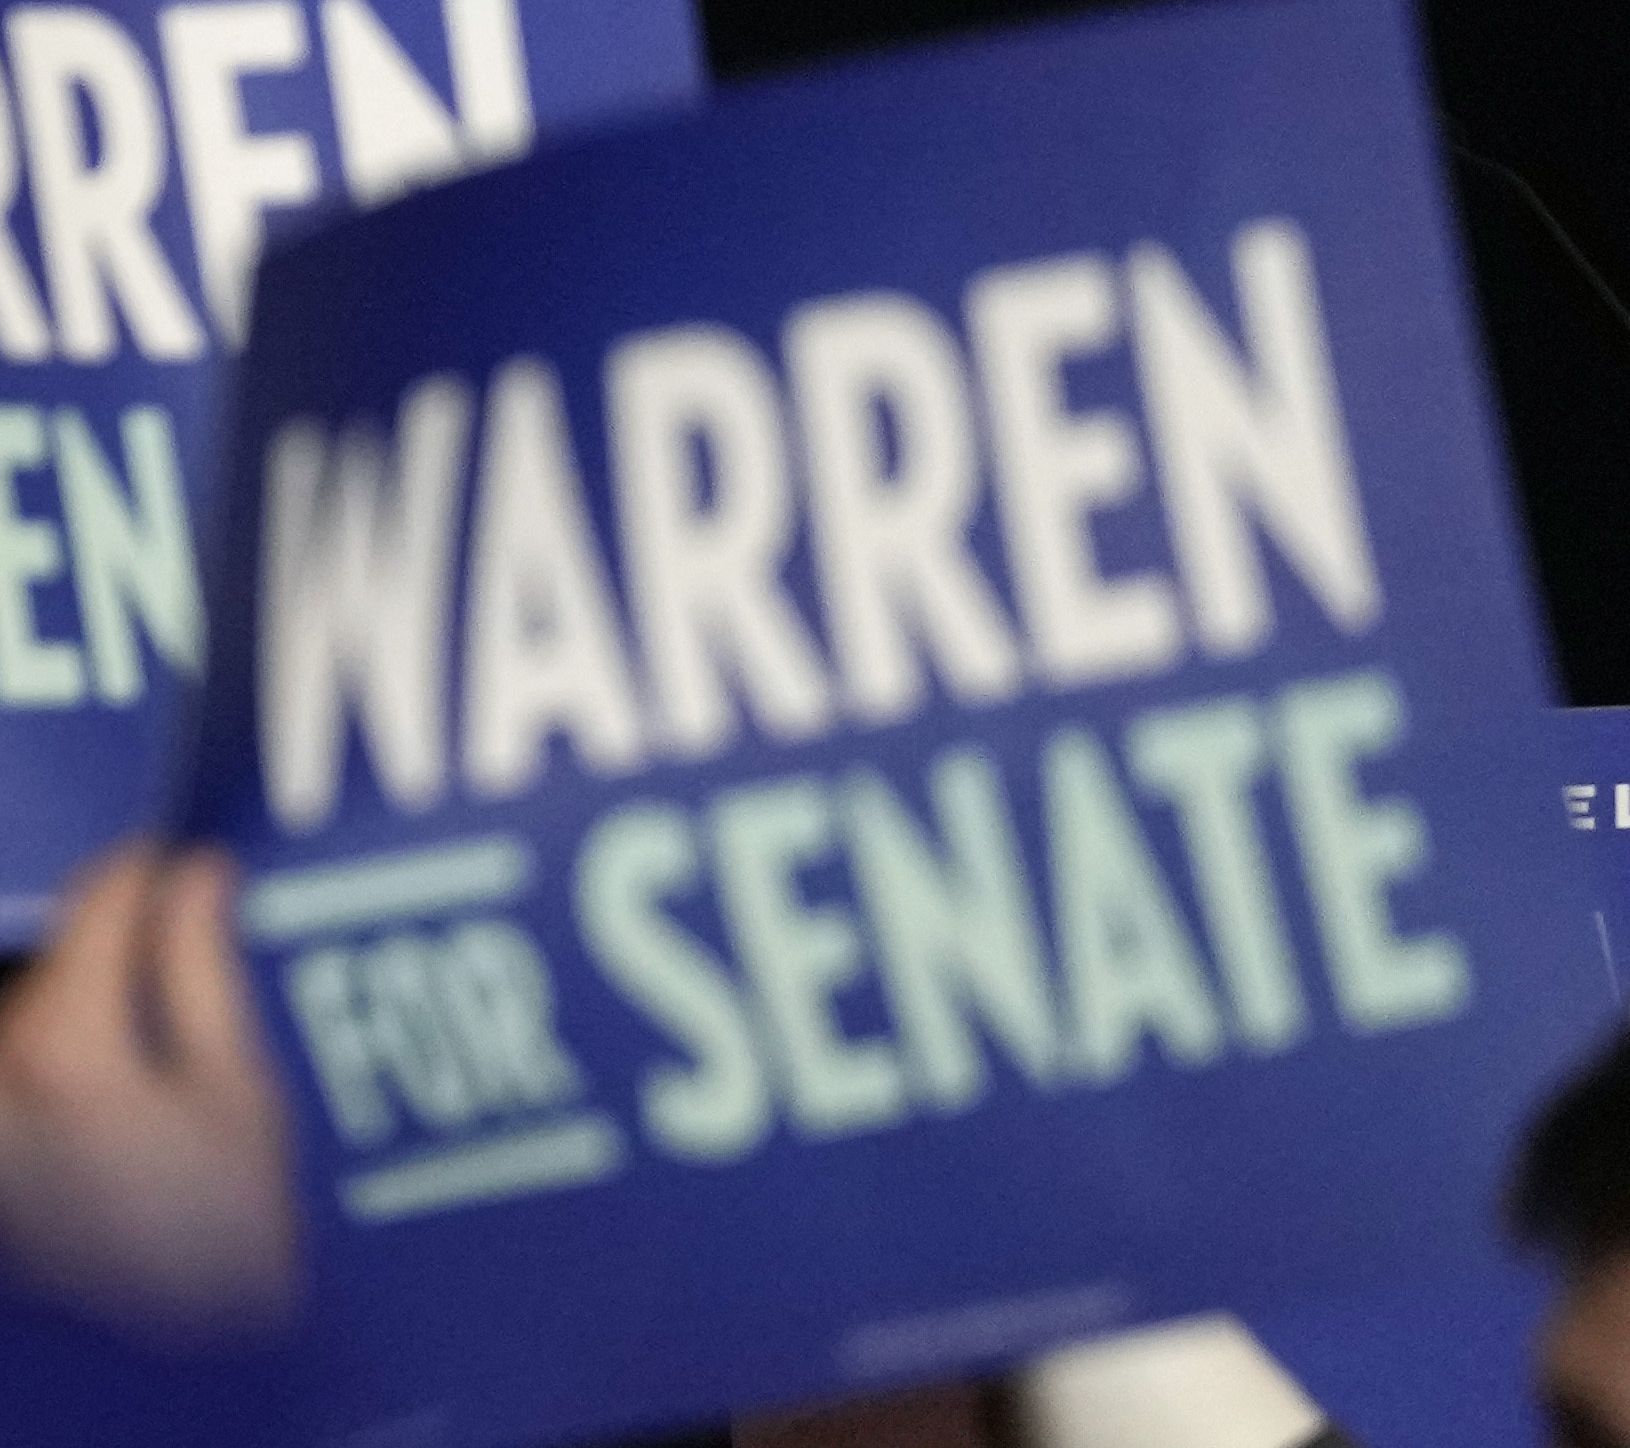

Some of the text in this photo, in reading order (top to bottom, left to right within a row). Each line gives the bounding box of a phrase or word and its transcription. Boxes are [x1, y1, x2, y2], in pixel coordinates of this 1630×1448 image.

[256, 215, 1382, 832] WARREN
[284, 666, 1470, 1165] FOR SENATE
